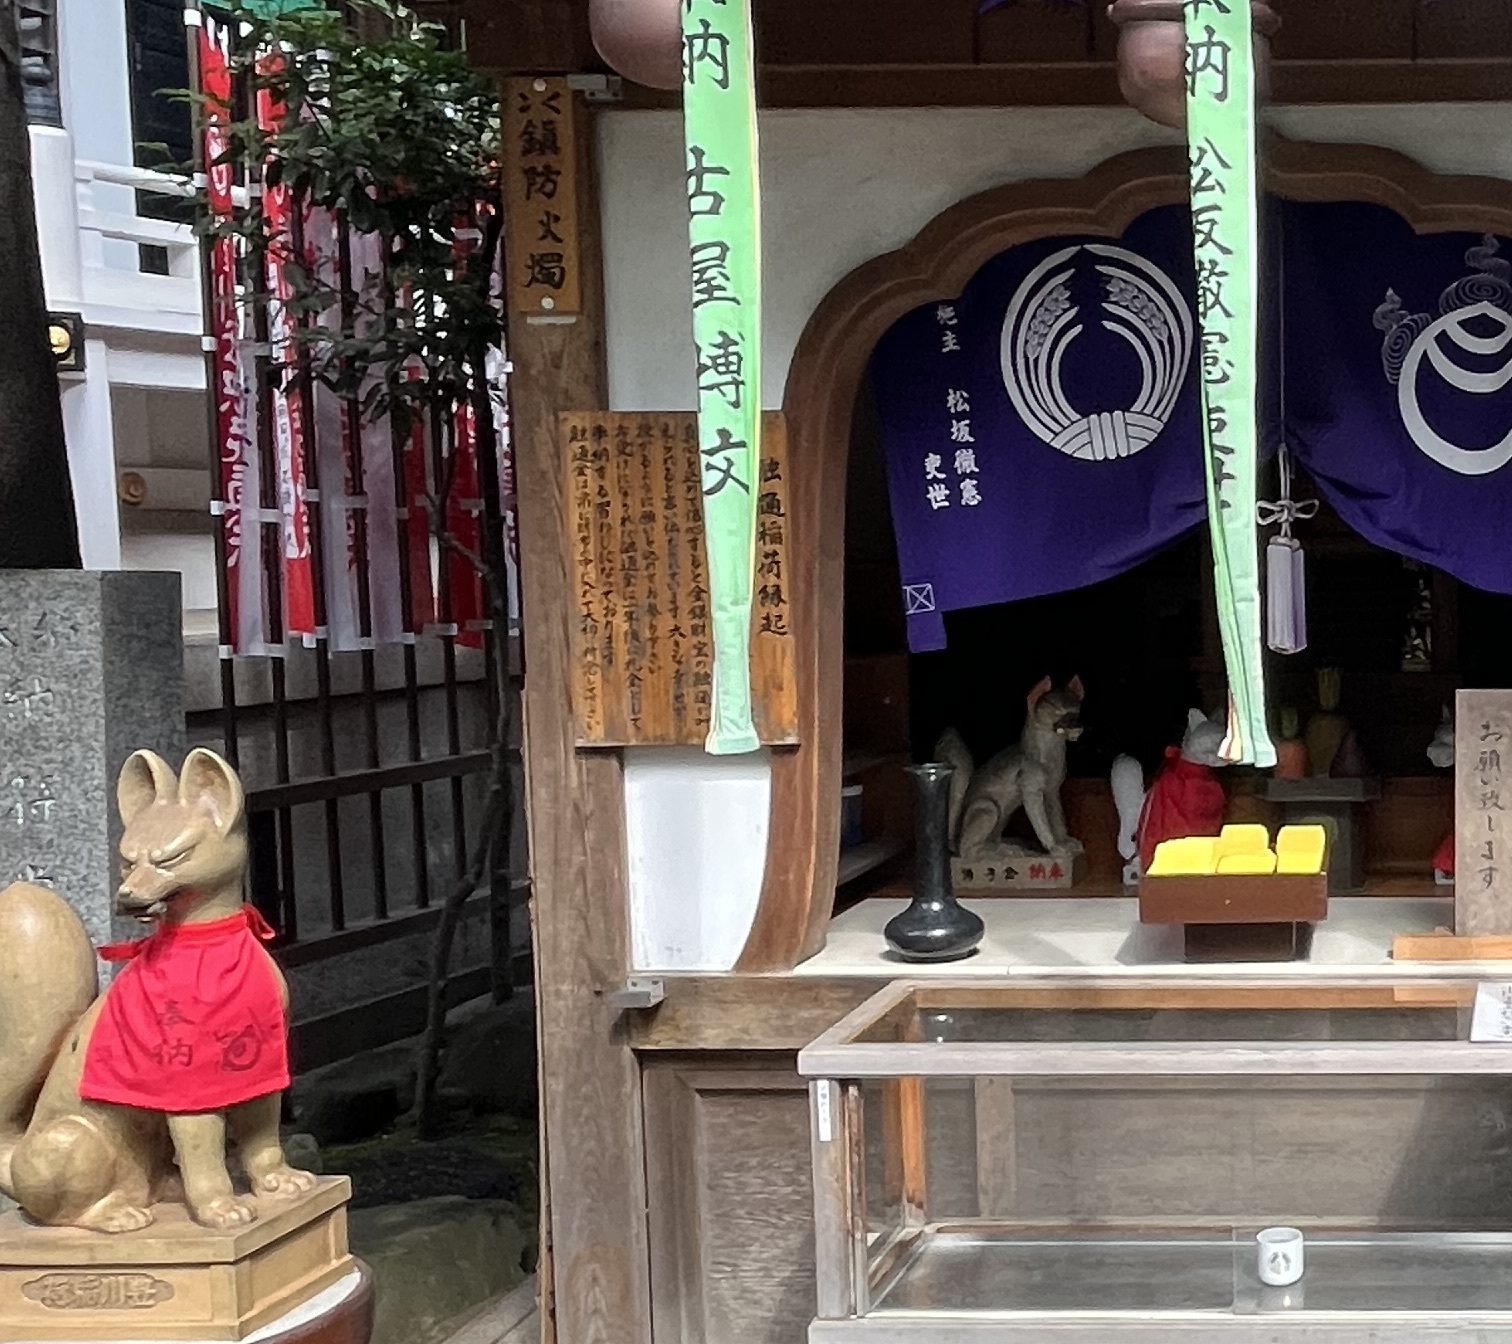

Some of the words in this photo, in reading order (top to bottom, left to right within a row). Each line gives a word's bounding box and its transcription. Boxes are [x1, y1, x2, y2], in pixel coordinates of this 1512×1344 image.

[1473, 720, 1506, 890] お願い致します
